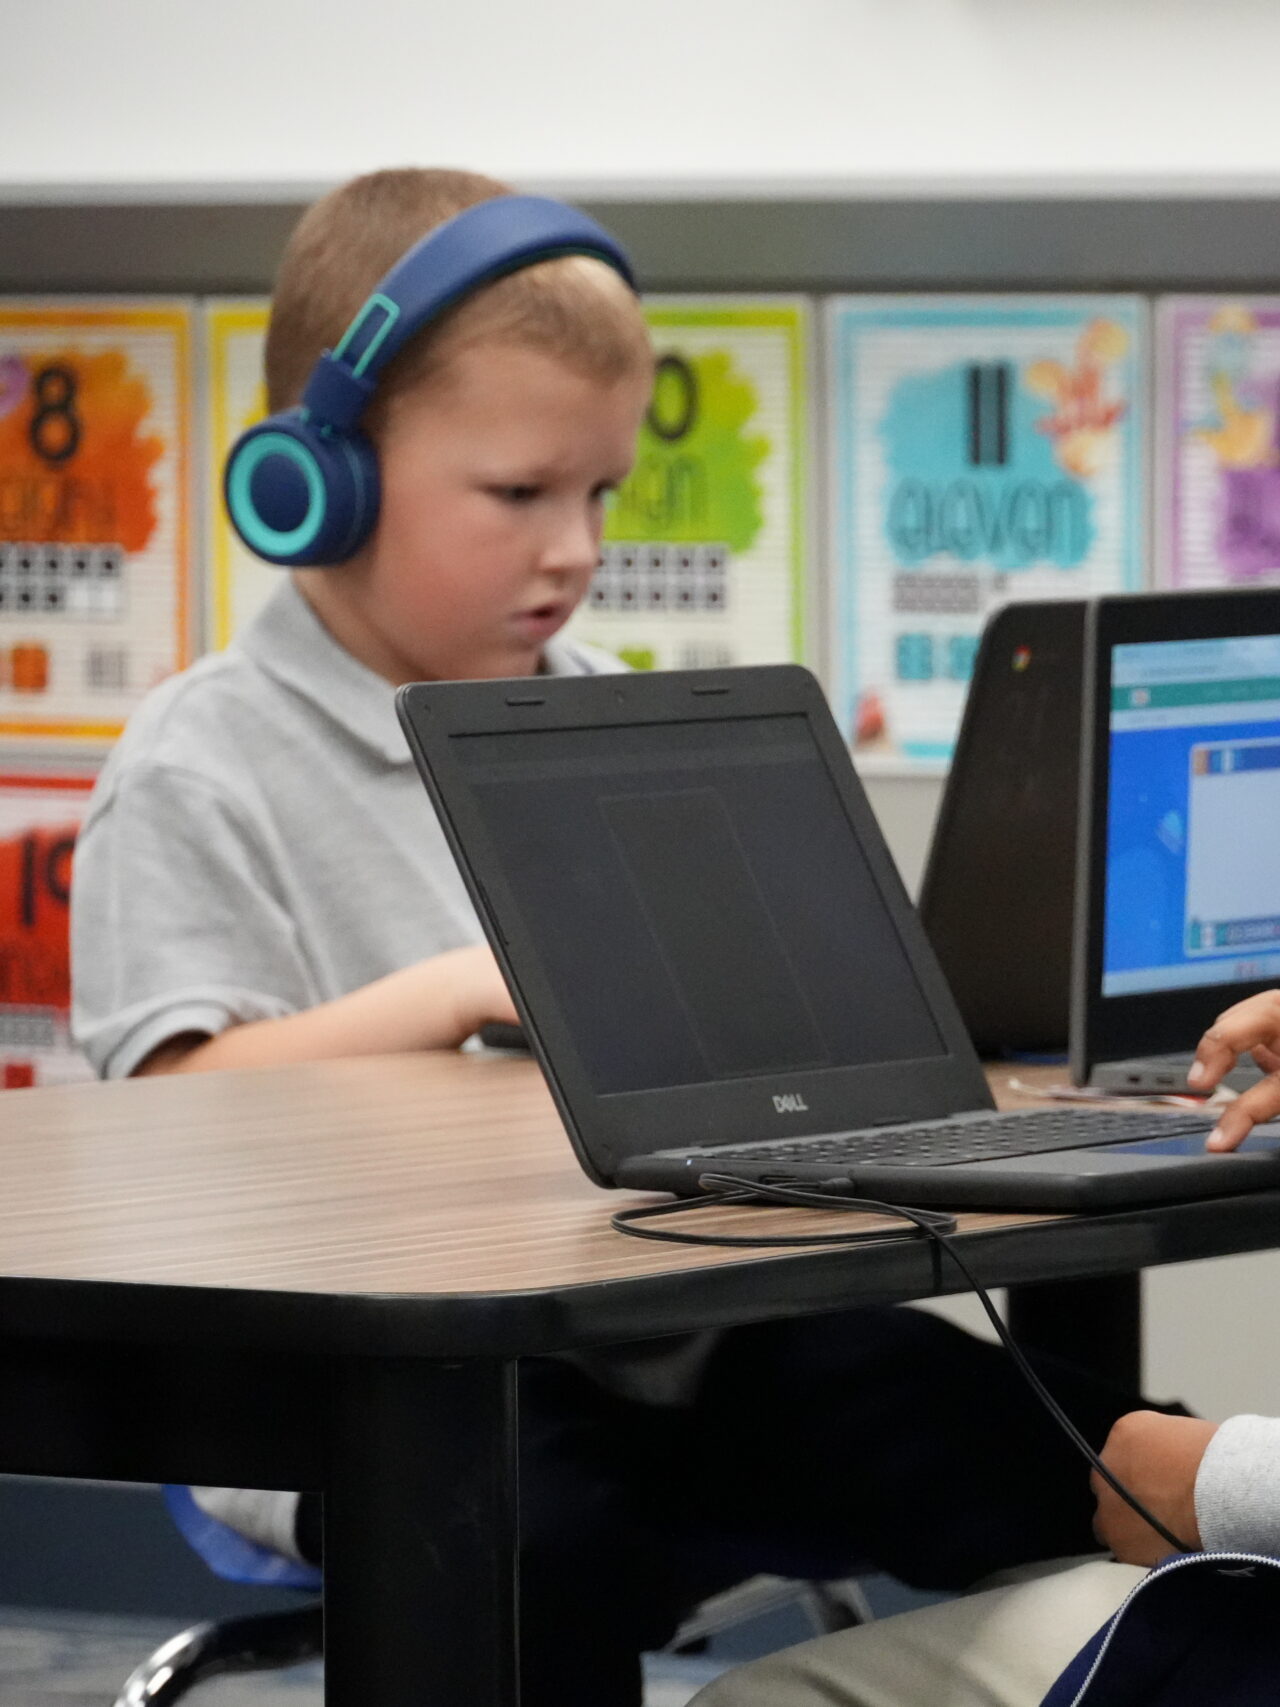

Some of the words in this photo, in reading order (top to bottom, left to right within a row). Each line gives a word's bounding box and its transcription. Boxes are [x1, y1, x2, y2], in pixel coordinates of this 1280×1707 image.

[31, 364, 82, 469] 8
[646, 354, 699, 443] 0
[965, 362, 1008, 466] 11
[772, 1093, 808, 1113] DELL
